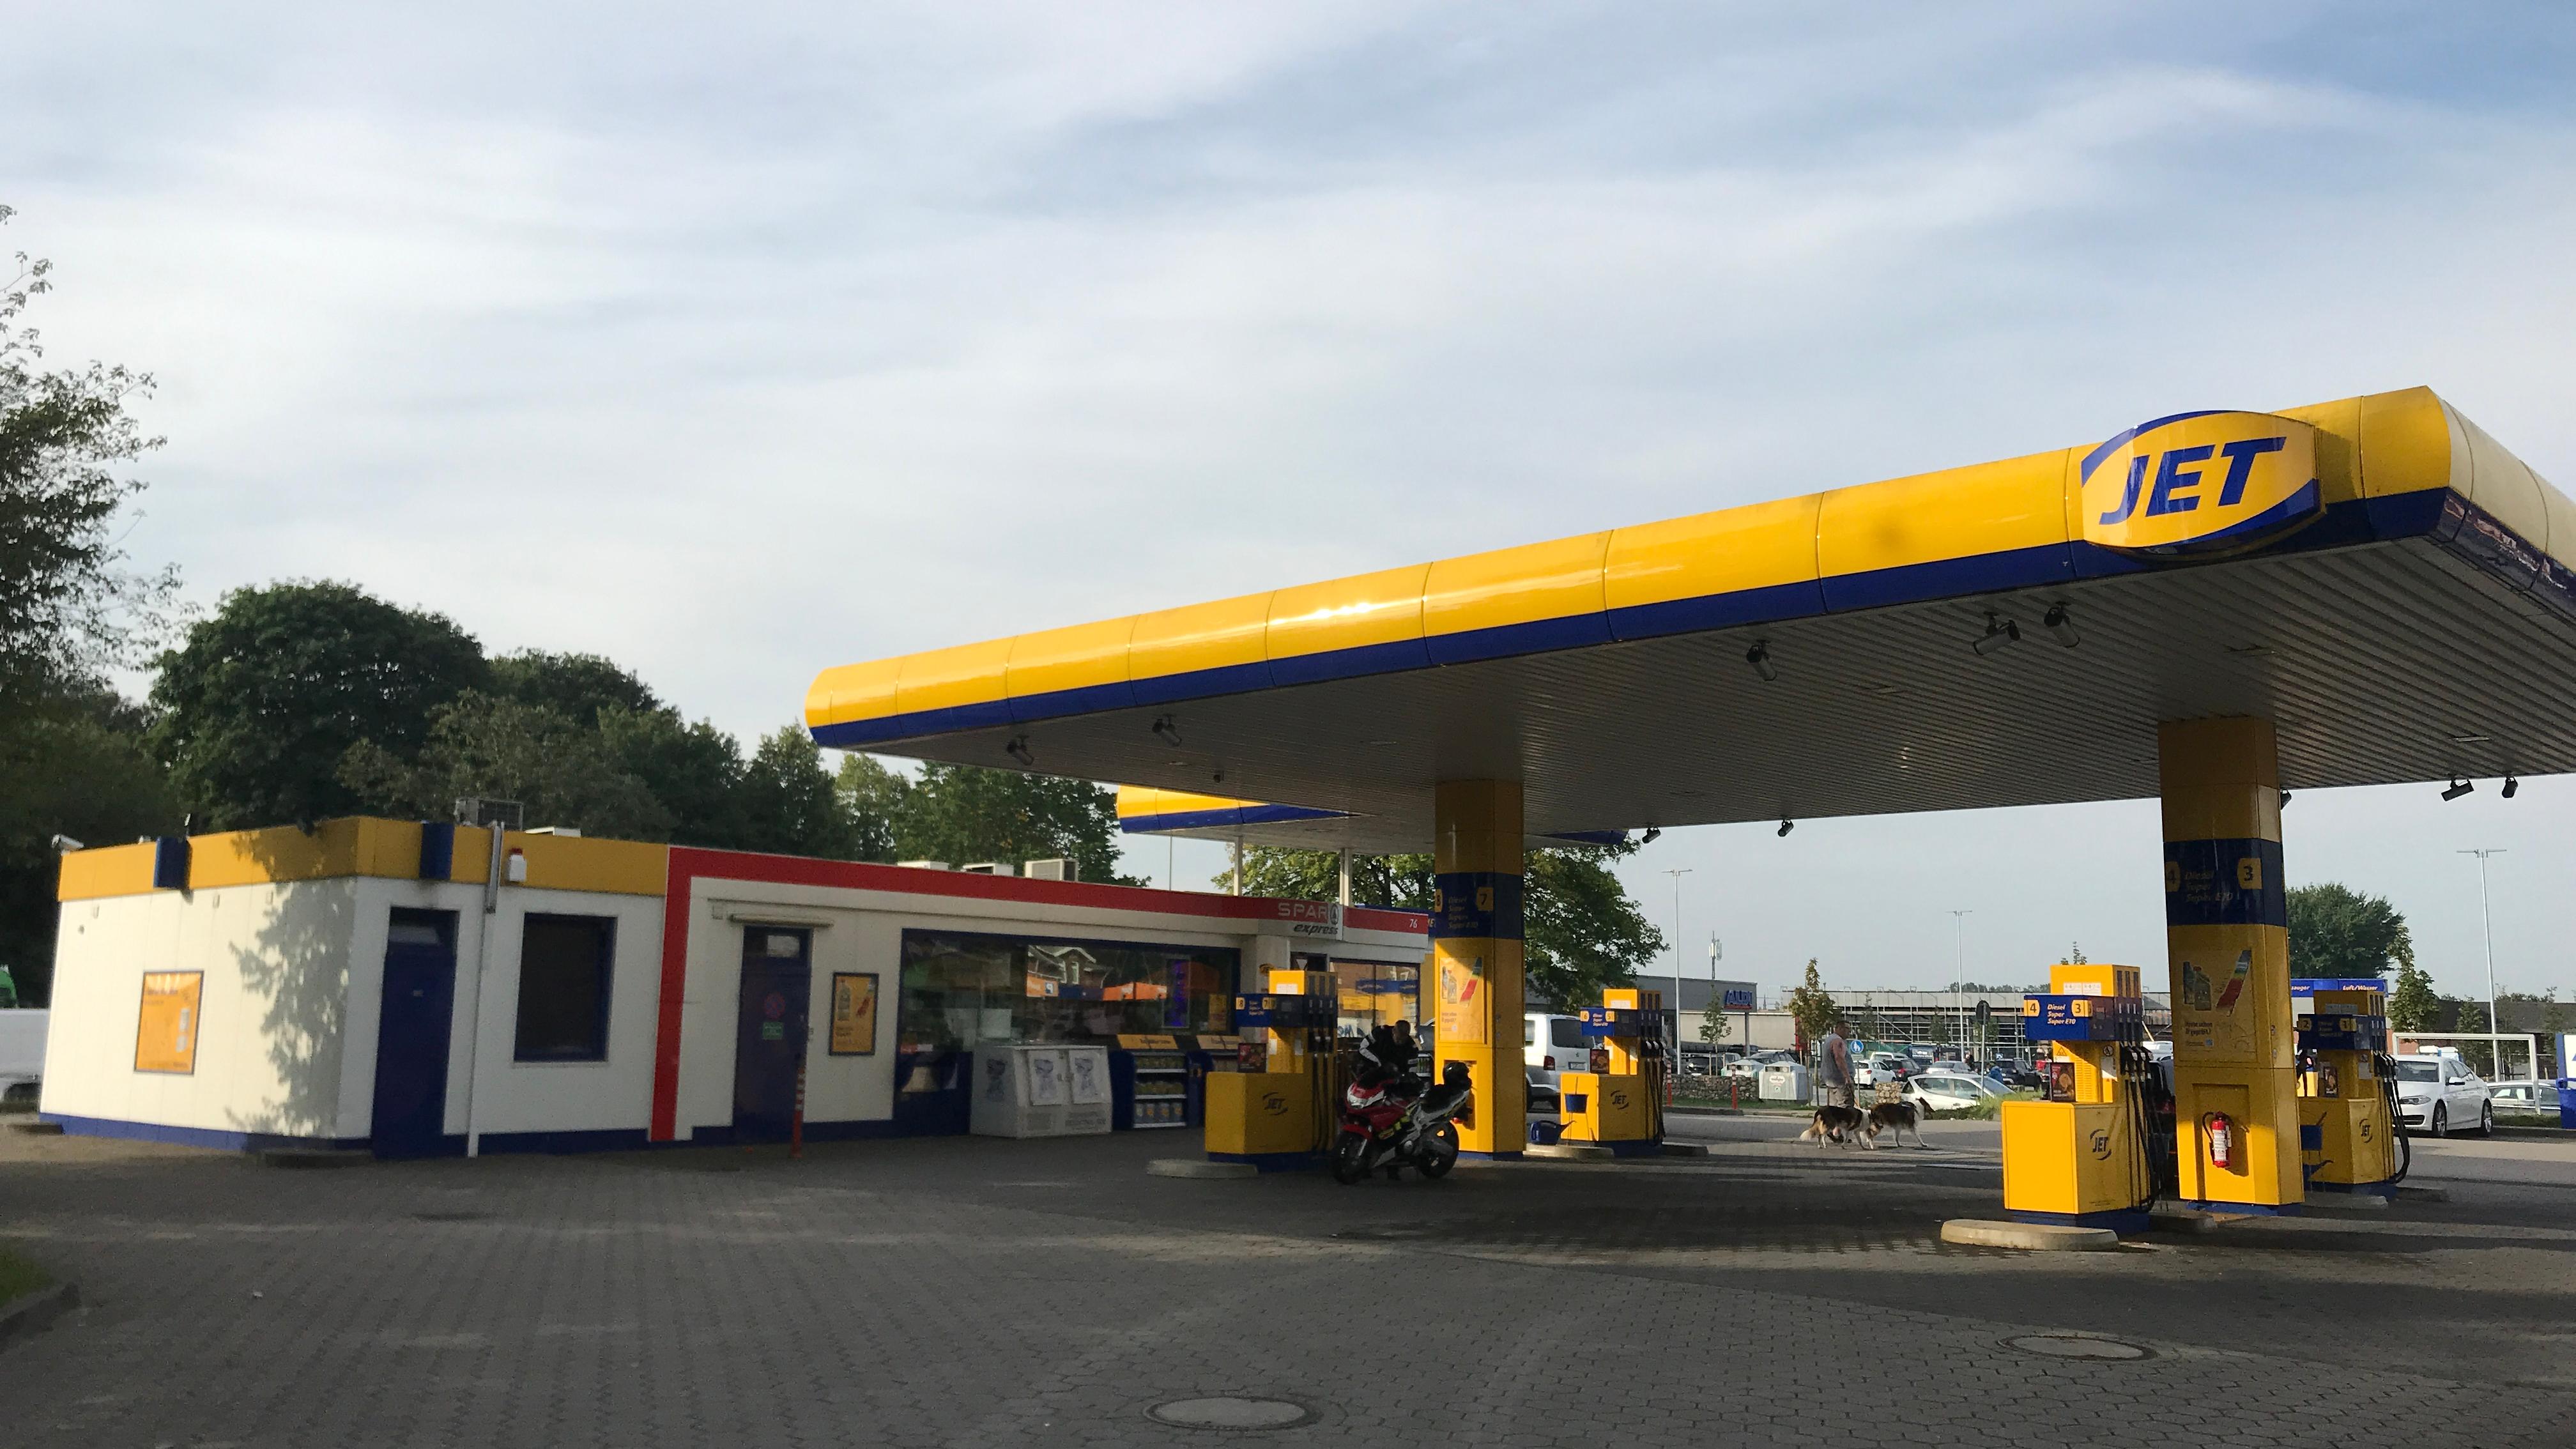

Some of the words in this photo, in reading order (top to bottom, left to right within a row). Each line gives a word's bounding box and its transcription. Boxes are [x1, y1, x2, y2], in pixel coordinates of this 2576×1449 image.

[2099, 436, 2287, 525] JET
[2244, 865, 2253, 881] 3
[1479, 893, 1487, 905] 7
[1278, 902, 1328, 921] SPAR
[1293, 924, 1338, 935] express
[1409, 919, 1418, 928] 76
[1725, 990, 1752, 1004] ALDI
[2030, 1003, 2037, 1013] 4
[2075, 1004, 2082, 1013] 3
[1264, 1098, 1285, 1110] JET
[1612, 1094, 1627, 1104] JET
[2361, 1125, 2370, 1137] JET
[2092, 1137, 2108, 1153] JET
